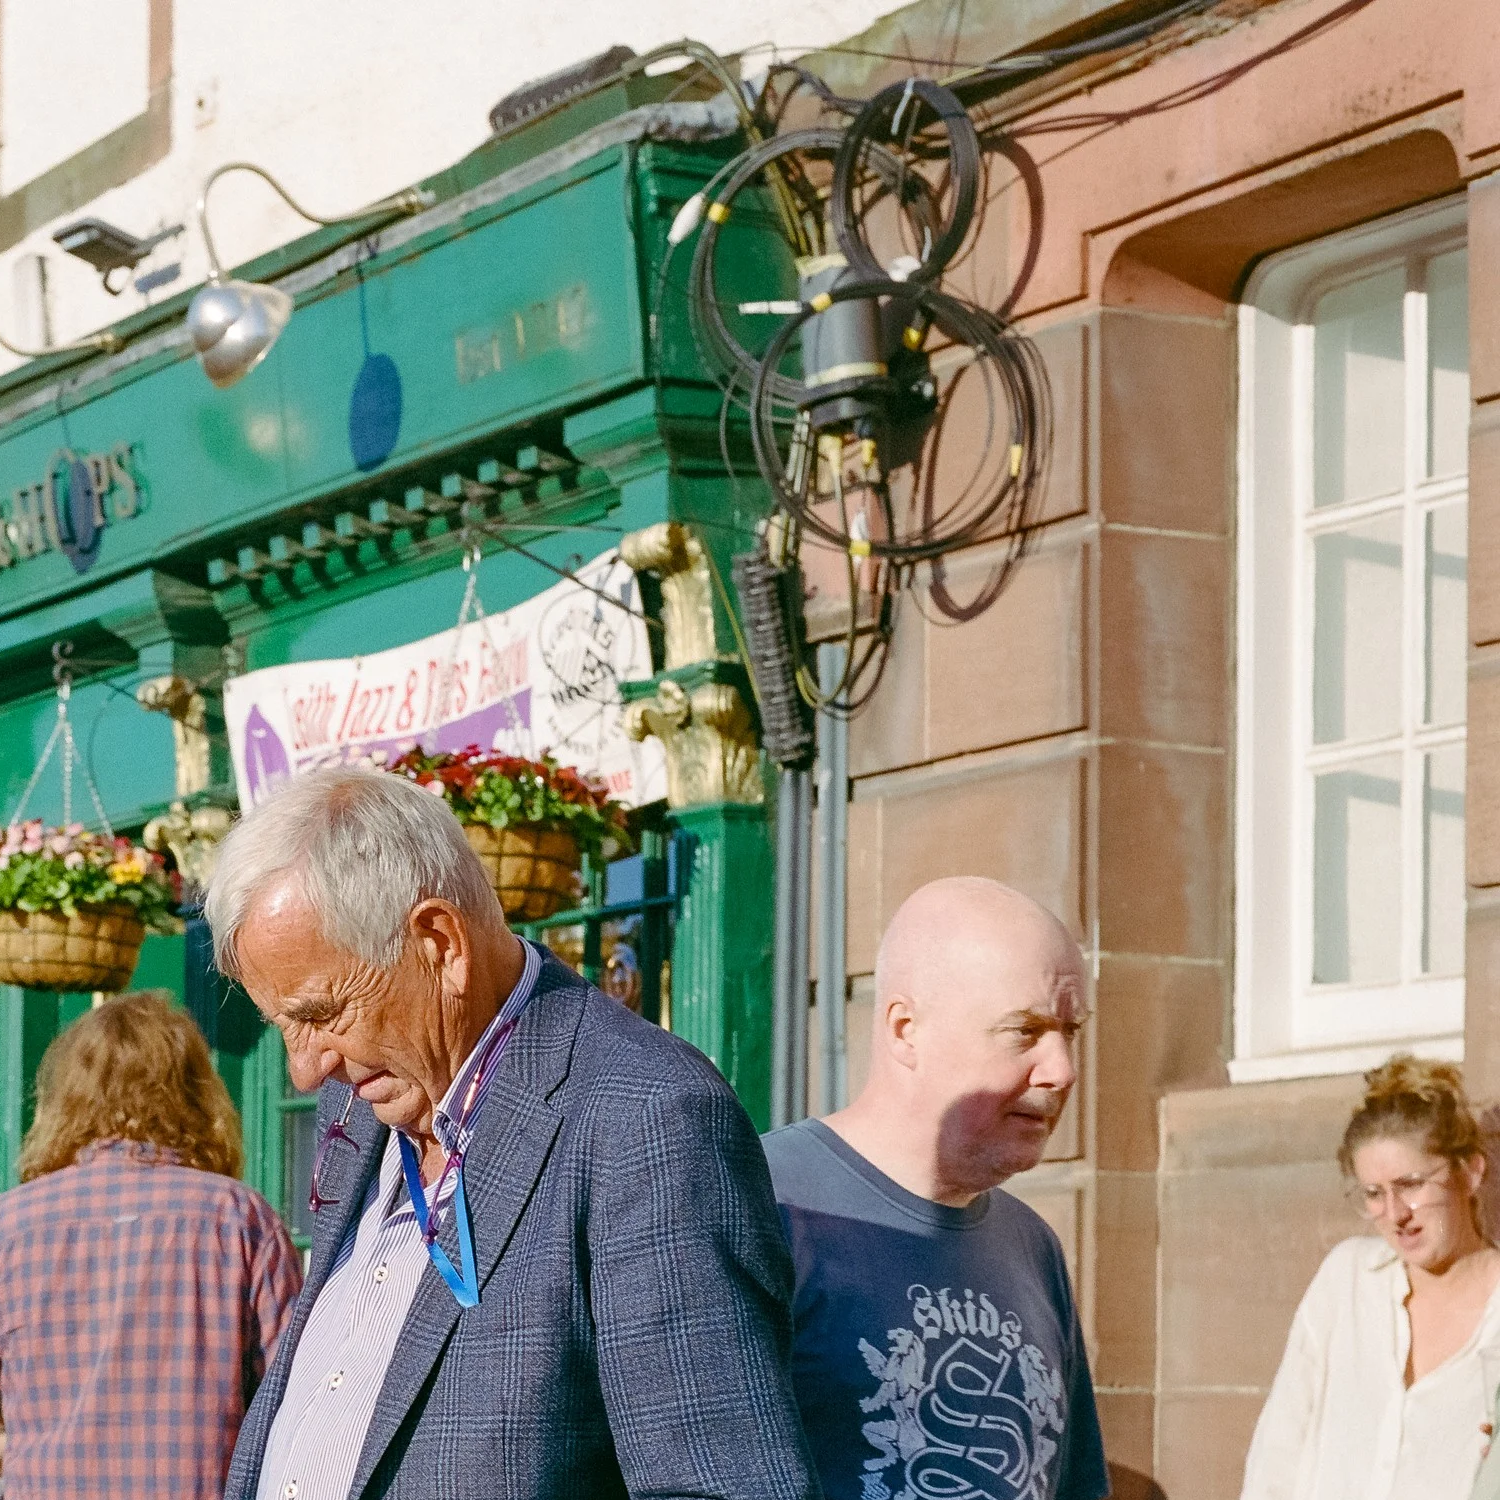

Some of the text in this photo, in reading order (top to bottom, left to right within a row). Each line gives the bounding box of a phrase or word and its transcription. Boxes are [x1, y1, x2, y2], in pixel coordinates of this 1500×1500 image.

[335, 678, 396, 743] Jazz
[395, 667, 419, 732] &
[907, 1284, 1022, 1350] Skids
